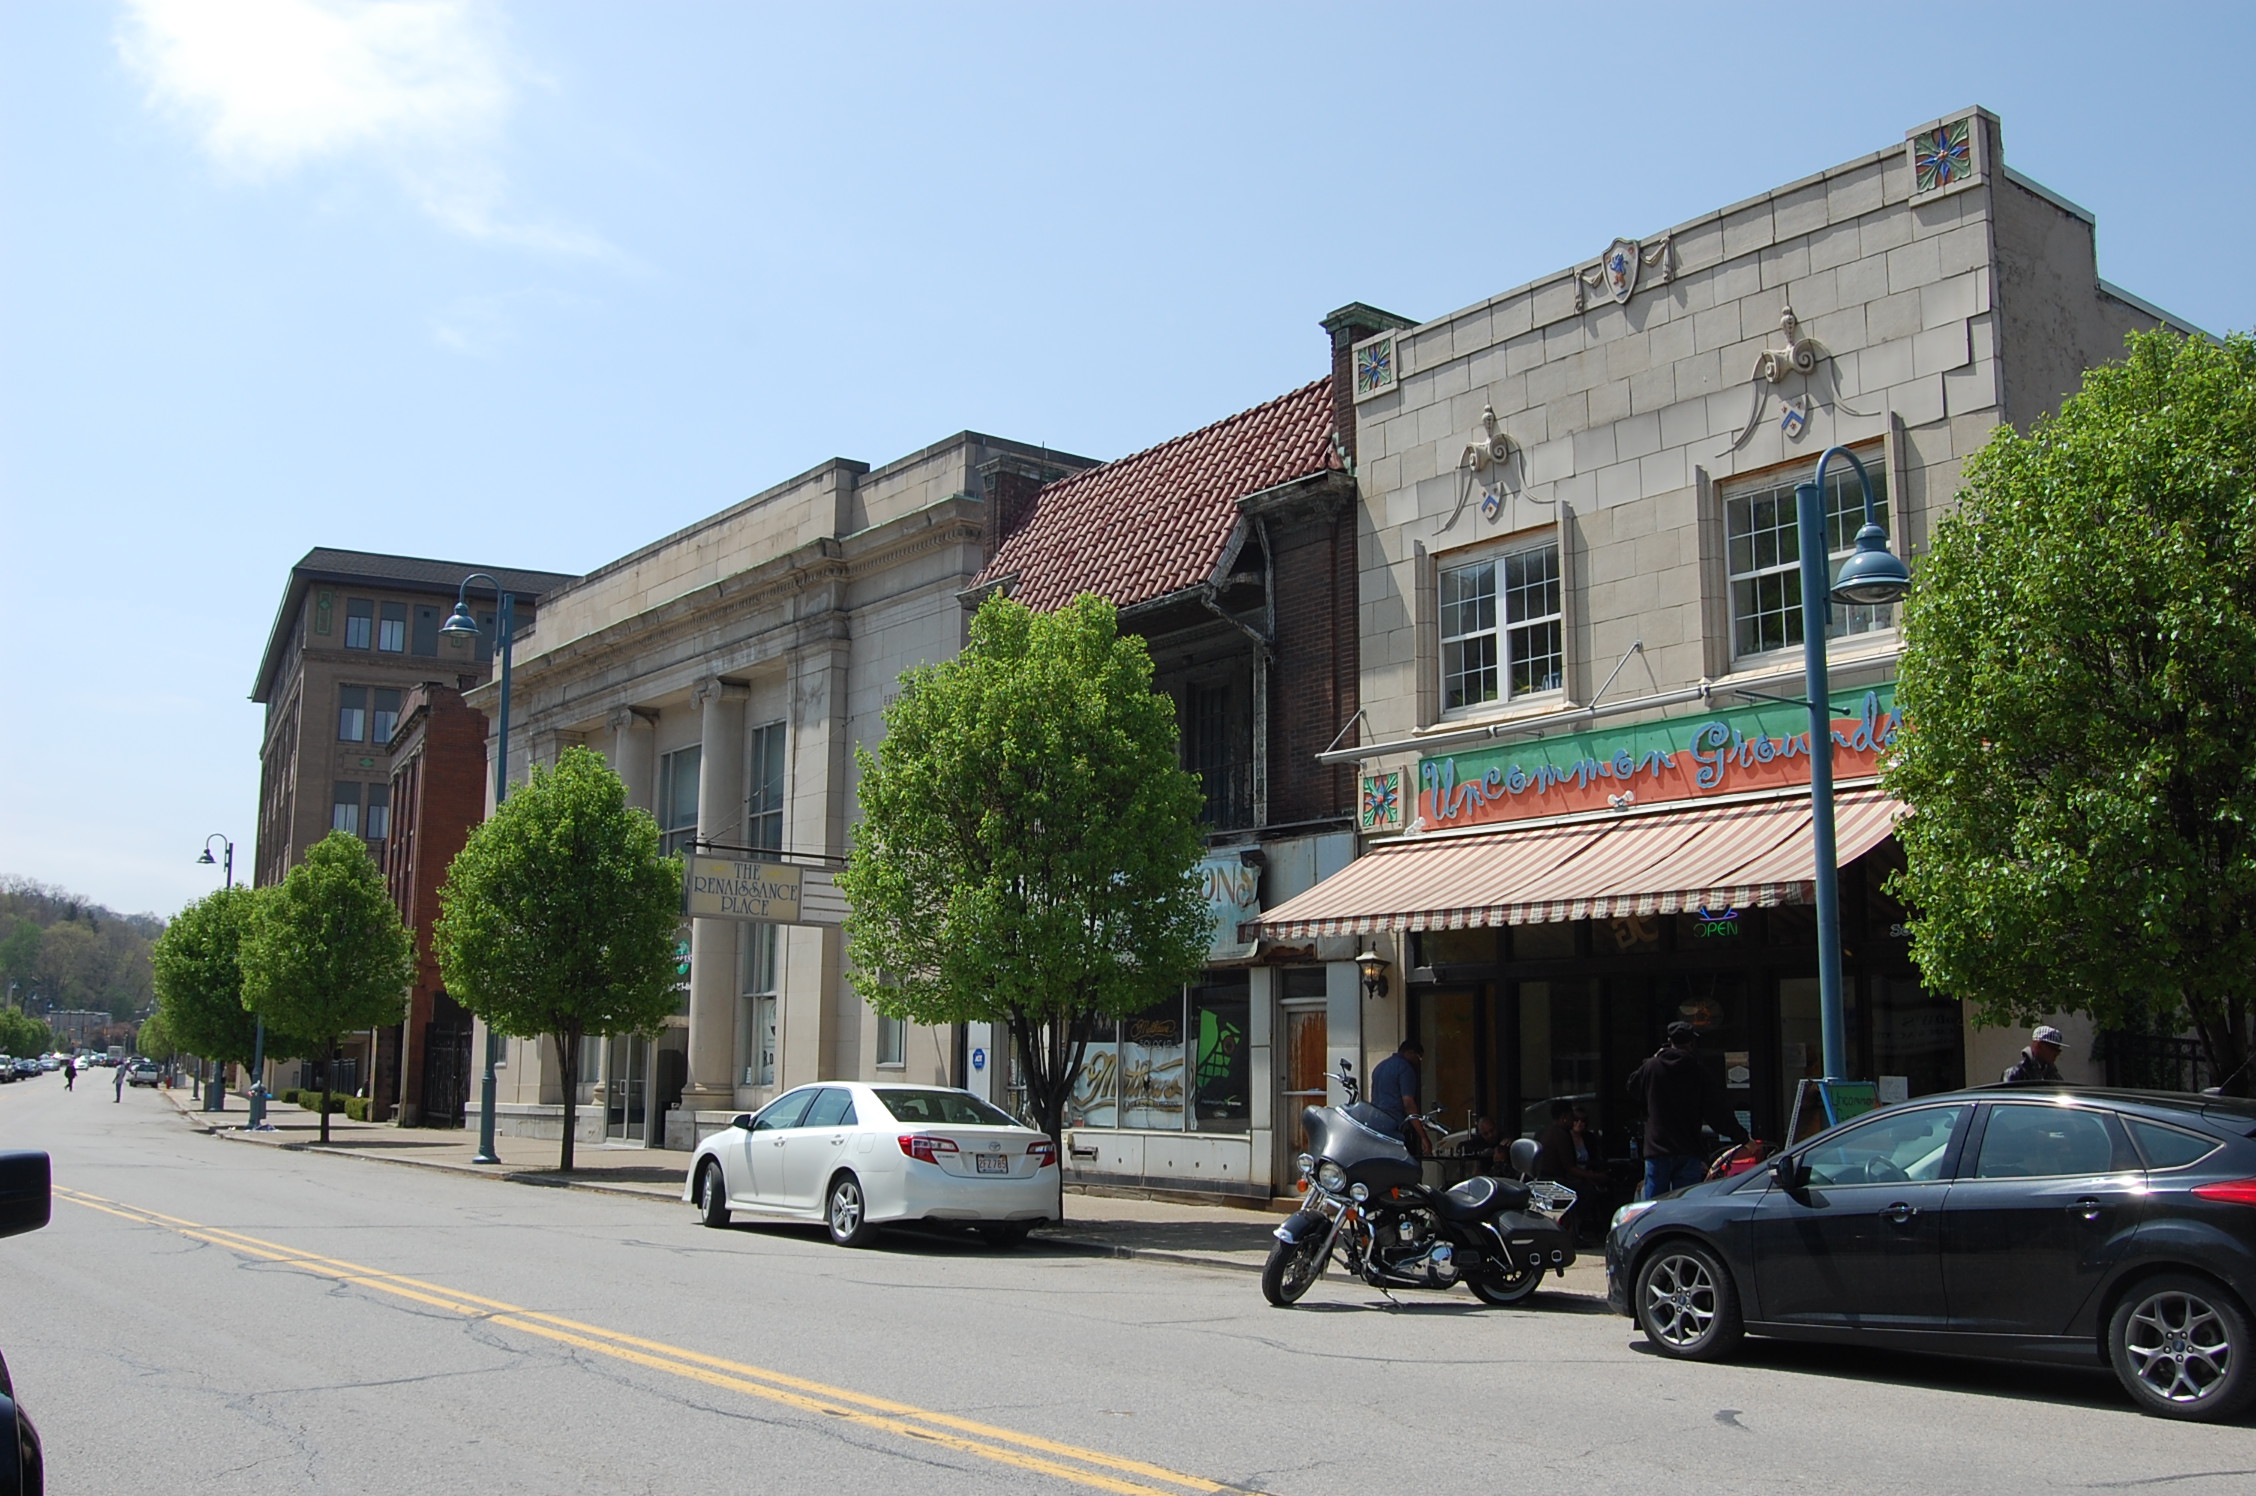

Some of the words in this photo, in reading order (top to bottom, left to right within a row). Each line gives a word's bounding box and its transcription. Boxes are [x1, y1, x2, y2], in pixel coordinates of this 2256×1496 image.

[1424, 749, 1675, 820] Uncommon
[734, 862, 761, 880] THE
[694, 876, 798, 901] RENAISSANCE
[721, 896, 769, 916] PLACE
[1693, 921, 1738, 938] OPEN
